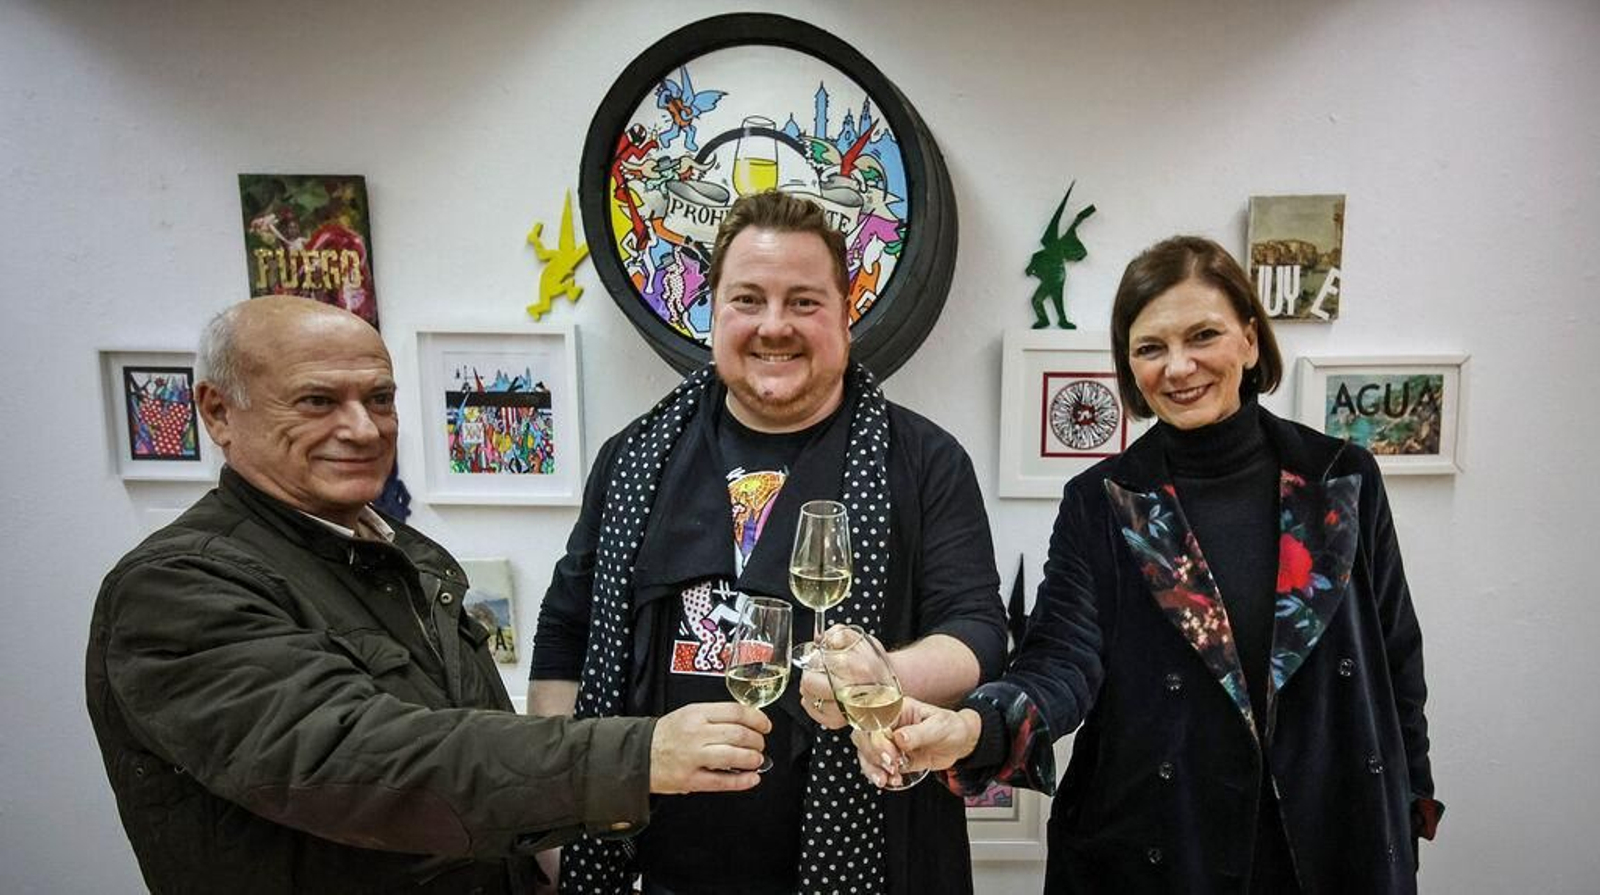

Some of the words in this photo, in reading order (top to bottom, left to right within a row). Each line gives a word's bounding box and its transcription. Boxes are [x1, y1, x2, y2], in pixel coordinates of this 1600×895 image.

[670, 198, 728, 226] PROH
[826, 210, 851, 235] TE
[254, 248, 364, 291] FUEGO
[1330, 381, 1440, 418] AGUA
